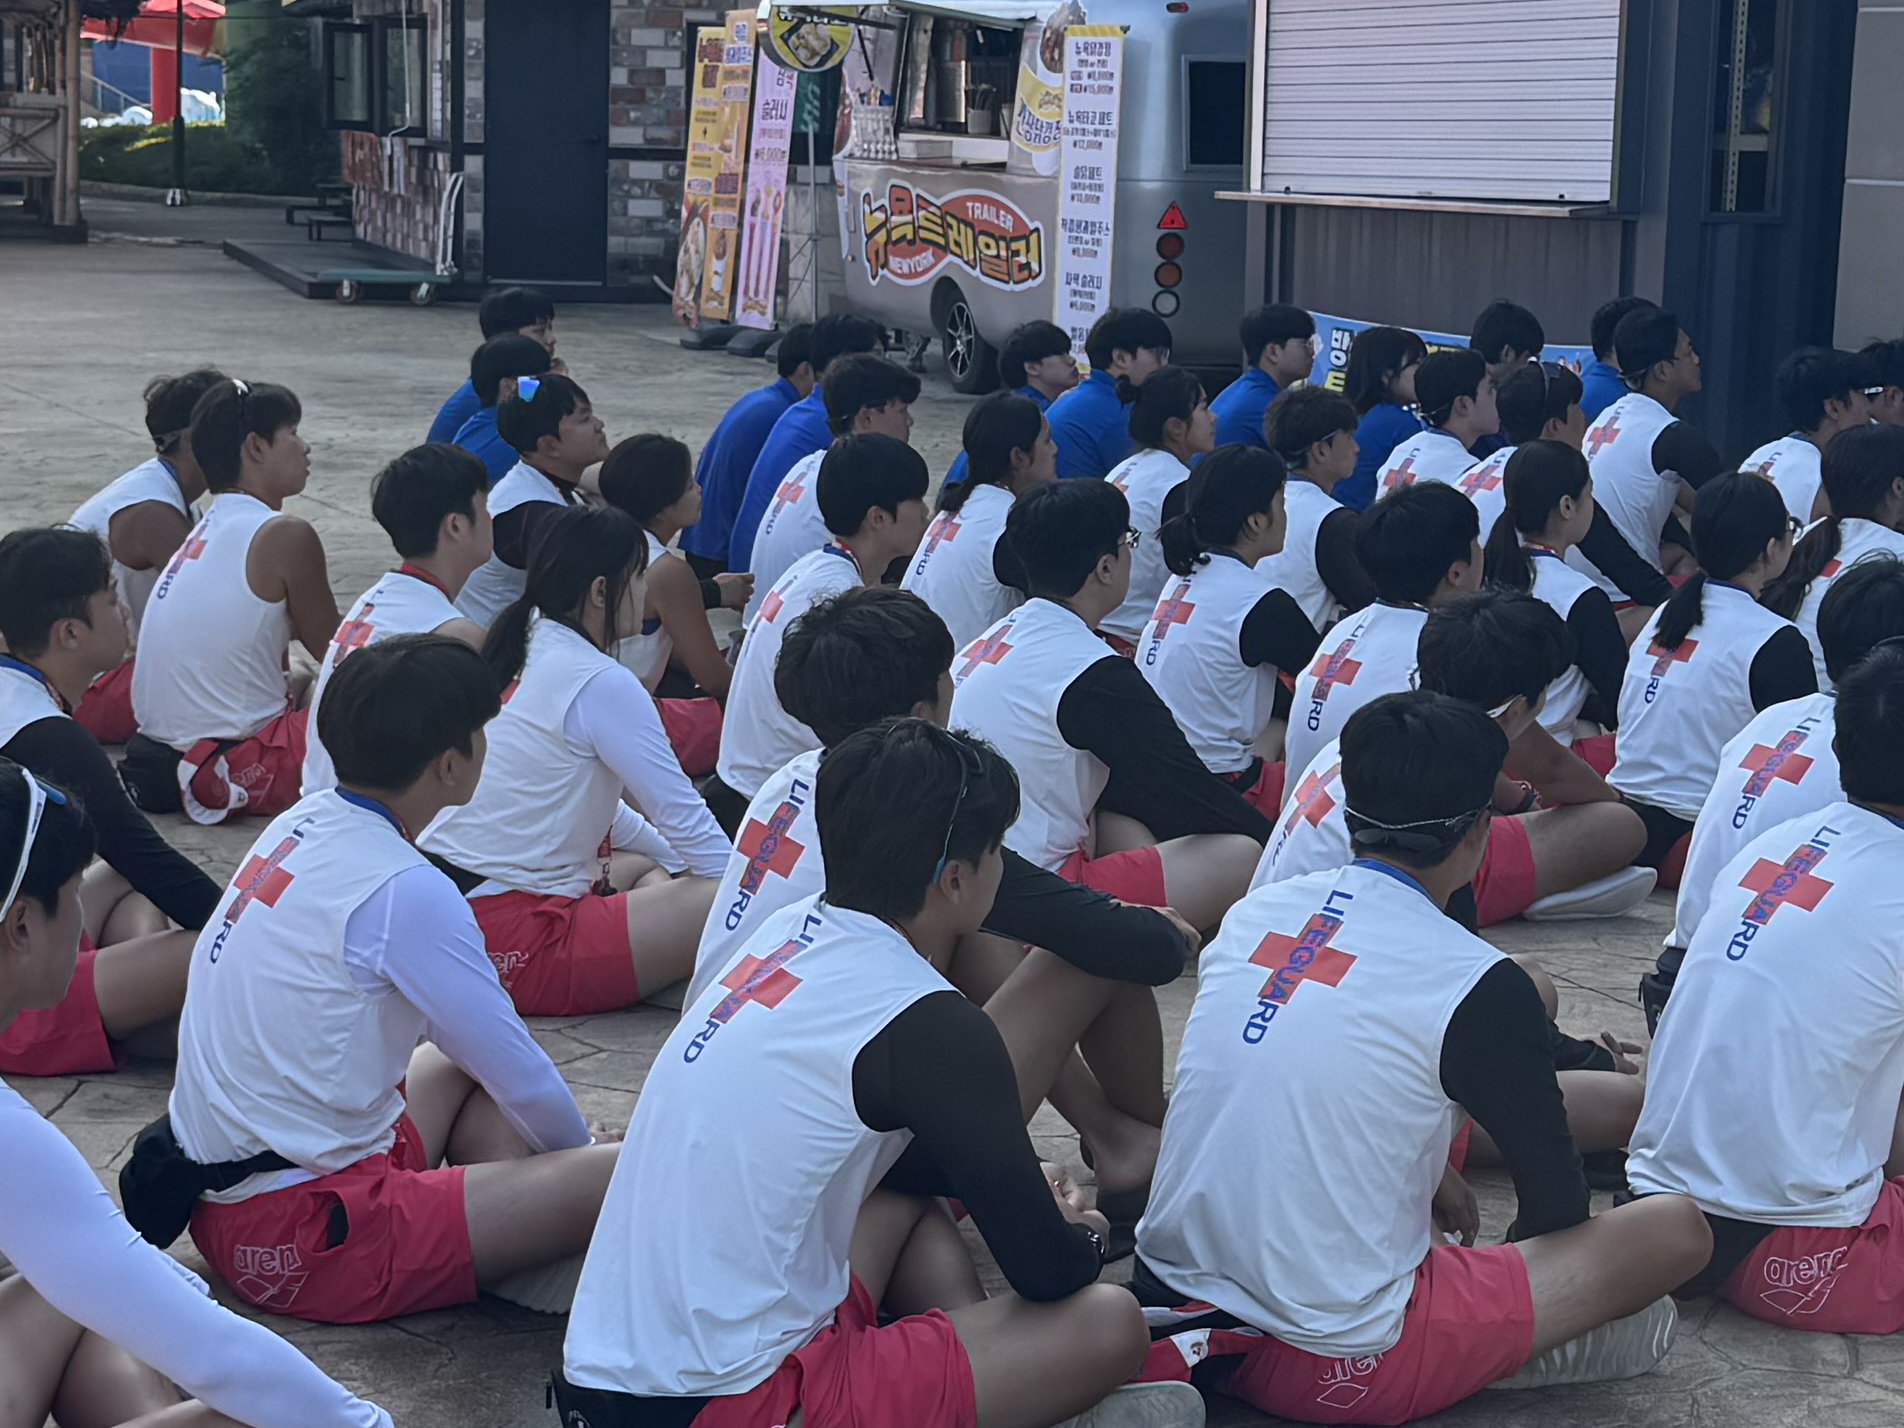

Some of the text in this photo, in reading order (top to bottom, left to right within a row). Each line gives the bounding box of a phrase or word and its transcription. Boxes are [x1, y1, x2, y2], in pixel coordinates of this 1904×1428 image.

[761, 98, 789, 122] 슬러시
[863, 183, 1042, 285] 뉴욕트레일러
[965, 201, 1014, 233] TRAILER
[724, 778, 811, 933] LIFEGUARD
[1727, 825, 1843, 961] LIFEGUARD
[682, 913, 823, 1065] LIFEGUARD
[1242, 889, 1354, 1045] LIFEGUARD
